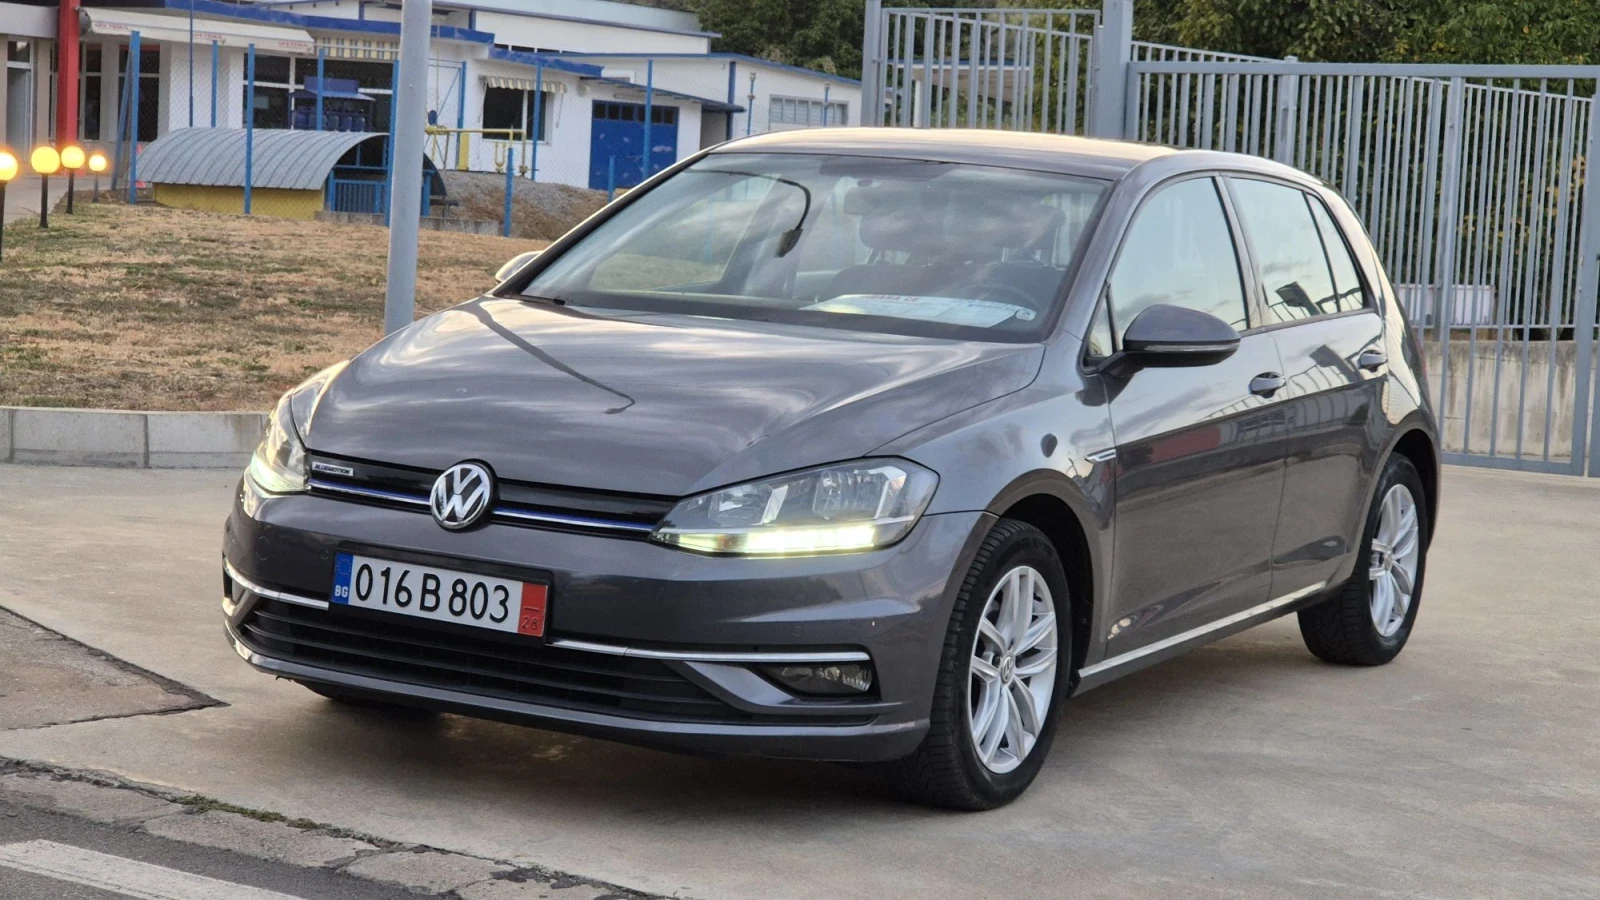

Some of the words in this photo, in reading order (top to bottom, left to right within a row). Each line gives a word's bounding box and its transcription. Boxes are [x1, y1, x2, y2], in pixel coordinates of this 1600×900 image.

[434, 465, 486, 525] VW
[334, 584, 349, 598] BG
[355, 563, 510, 623] 016B803
